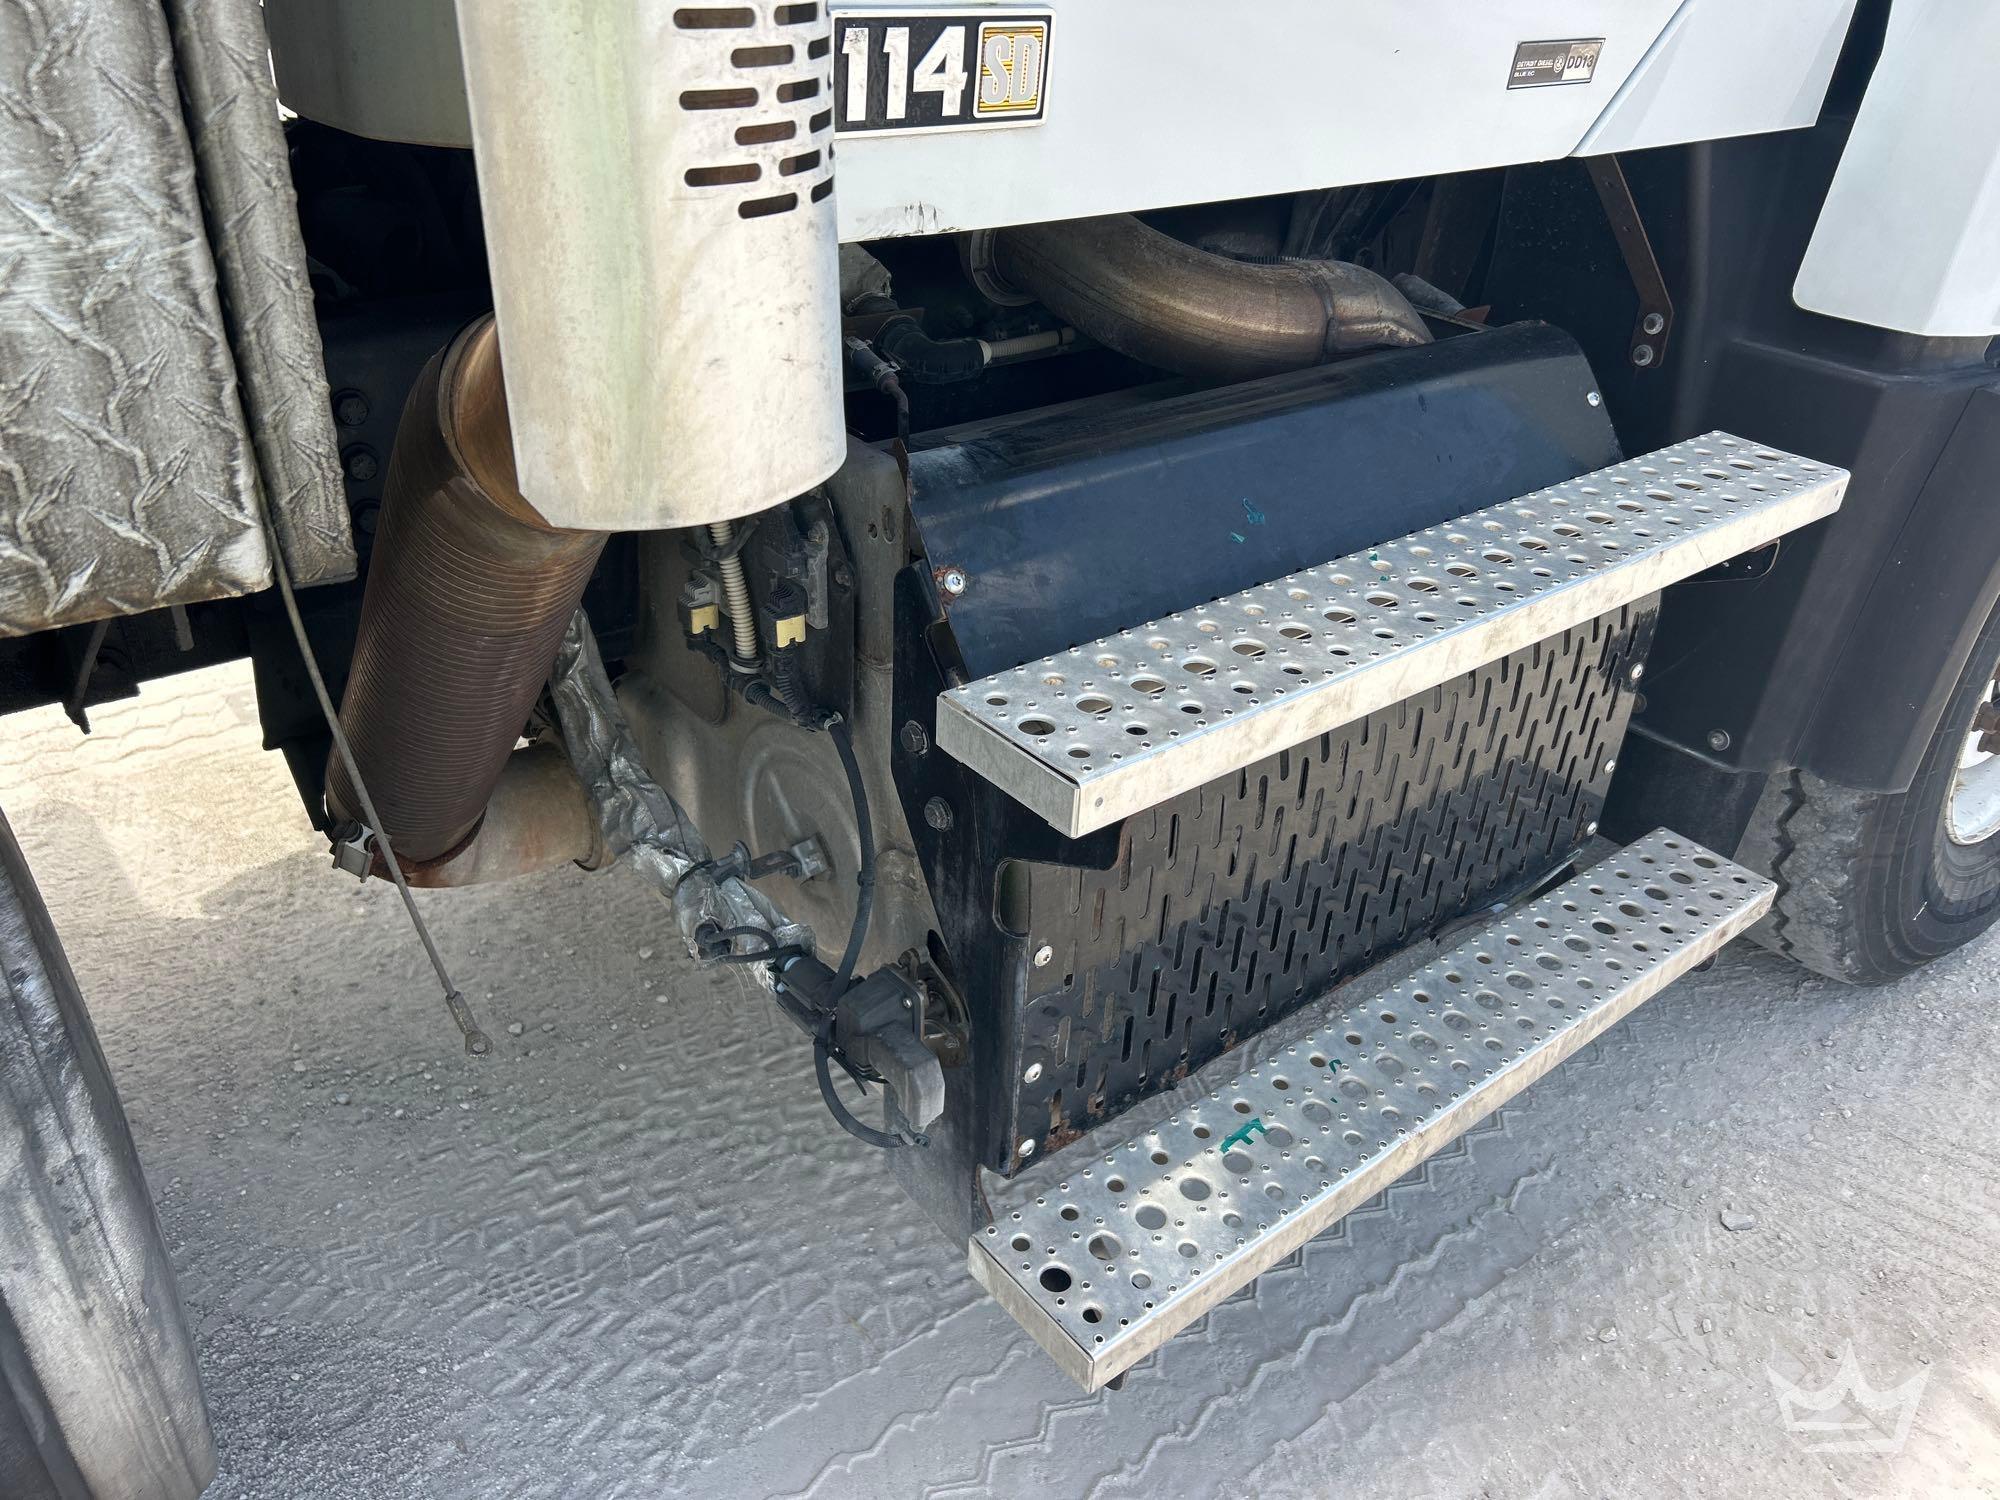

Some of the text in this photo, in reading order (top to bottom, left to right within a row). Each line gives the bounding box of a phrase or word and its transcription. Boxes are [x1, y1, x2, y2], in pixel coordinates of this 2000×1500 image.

[841, 26, 1042, 122] 114 SD
[1567, 55, 1594, 69] DD13
